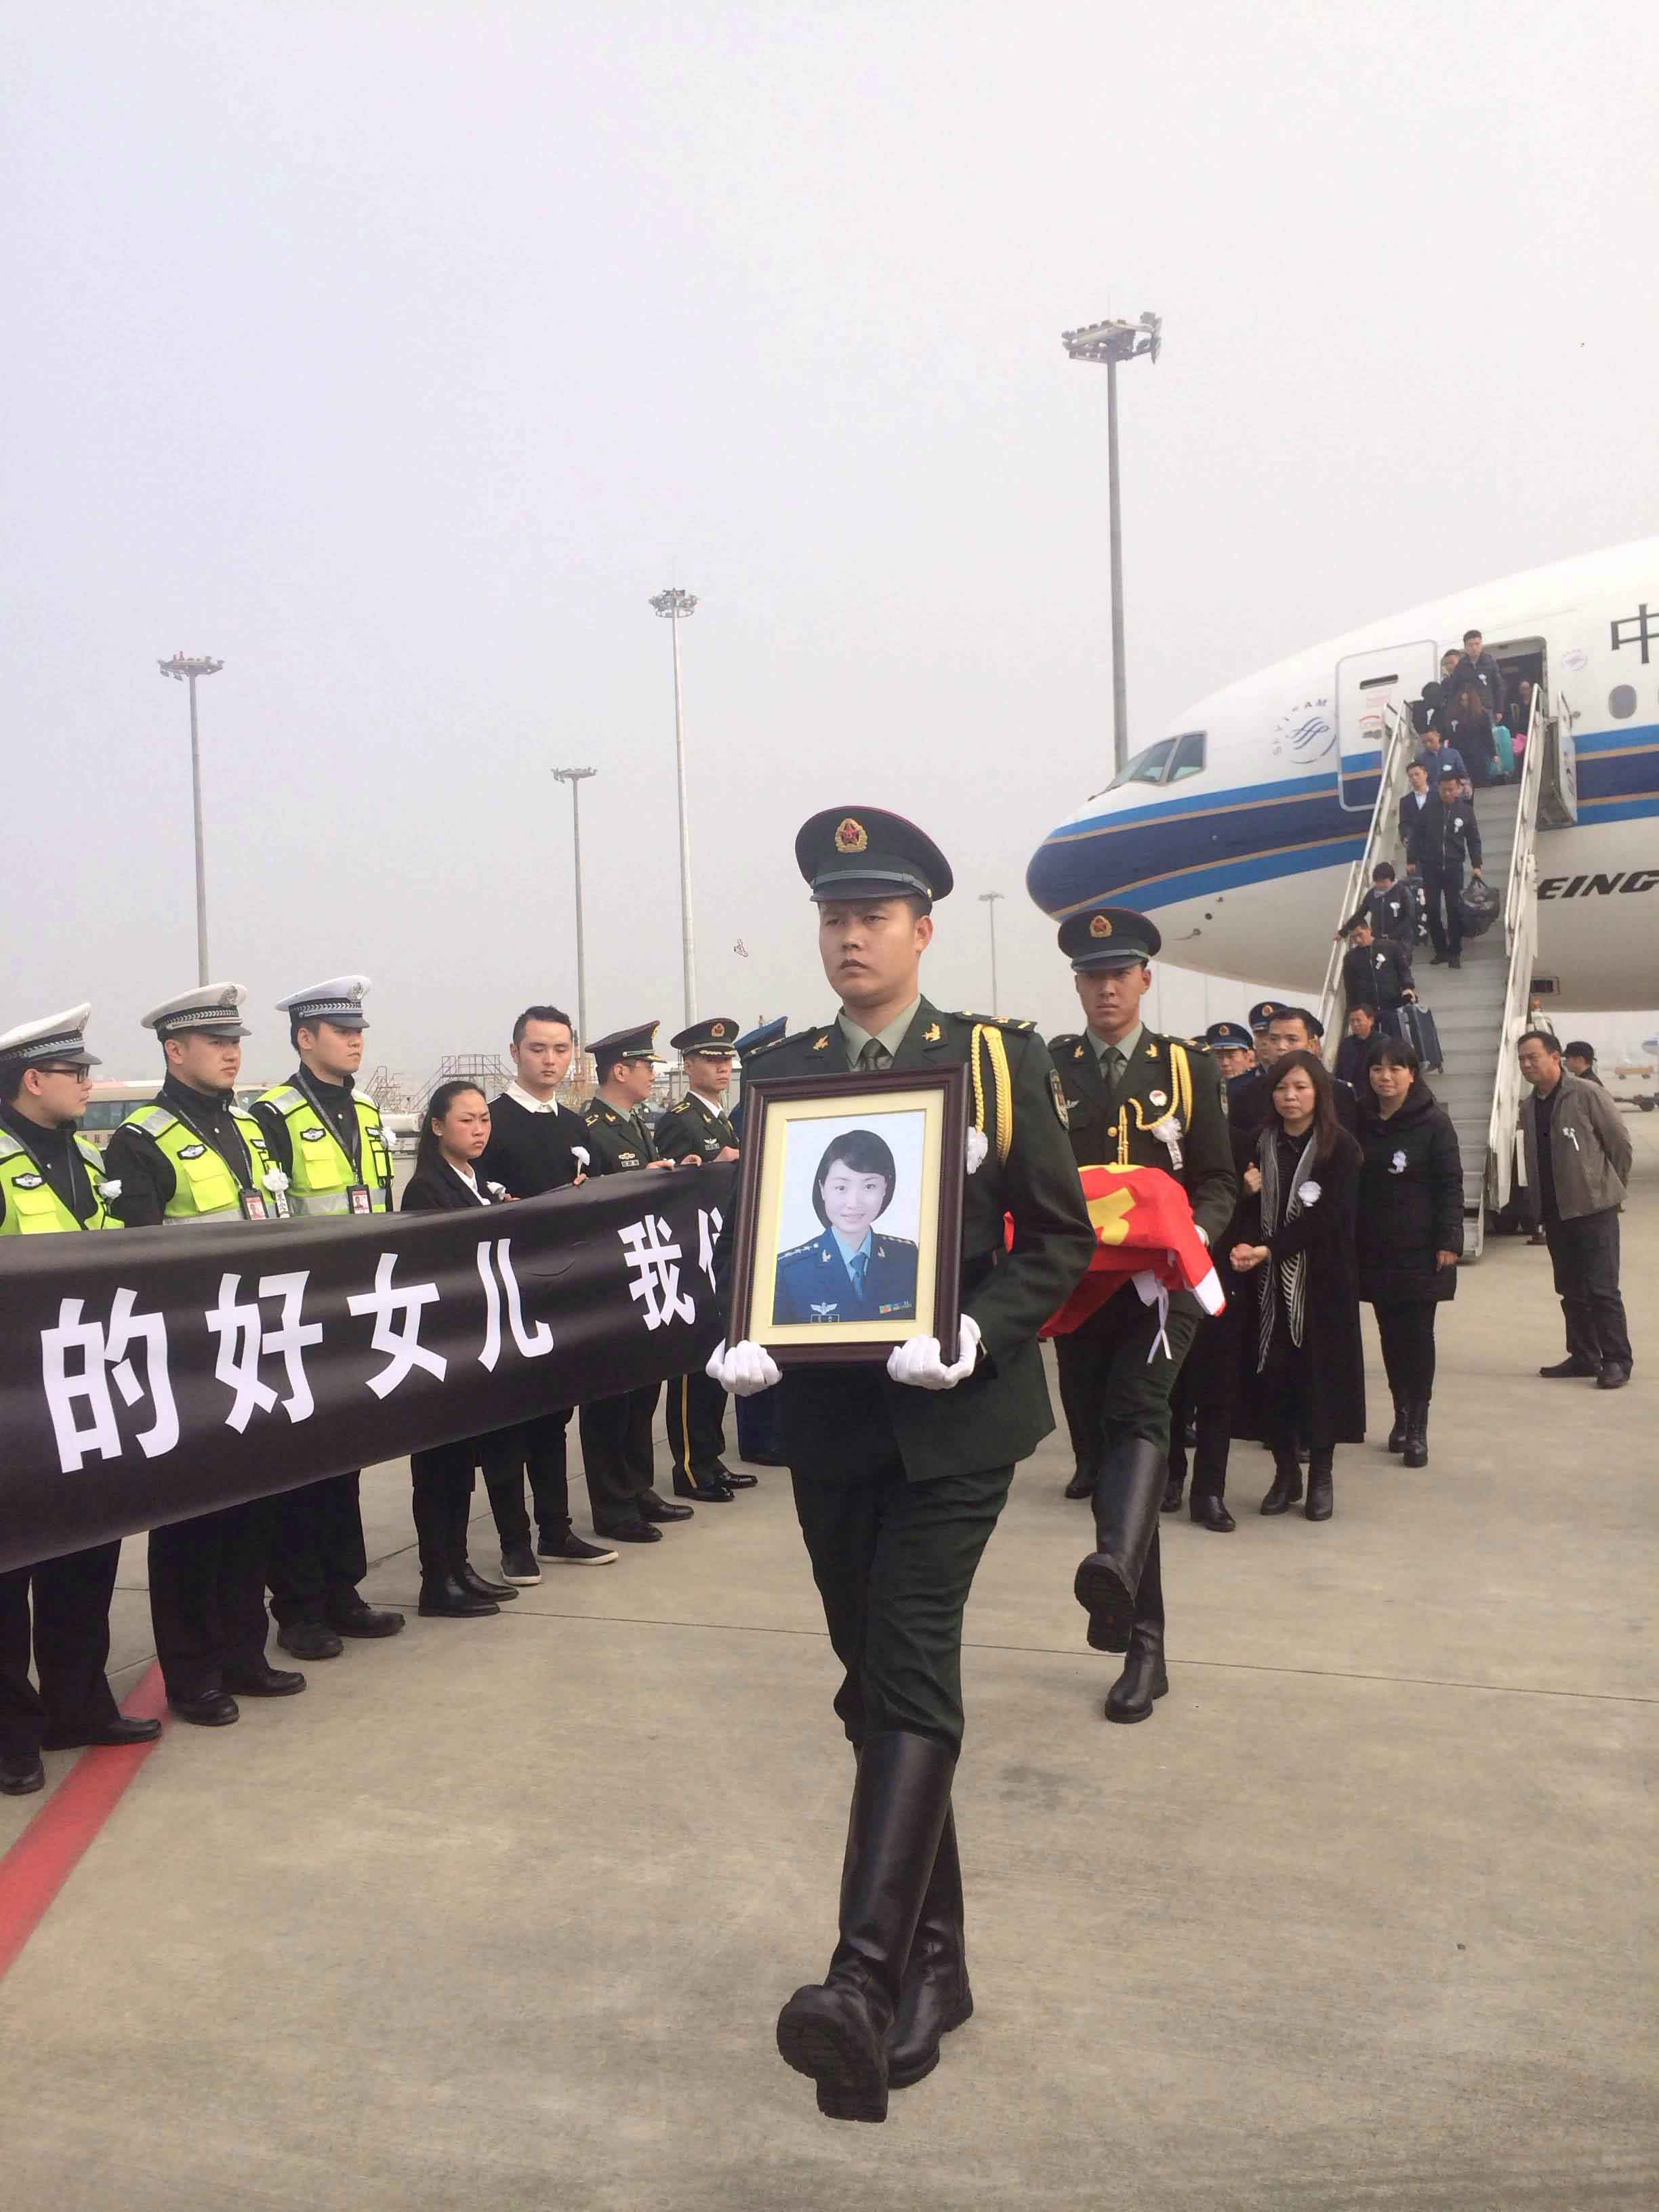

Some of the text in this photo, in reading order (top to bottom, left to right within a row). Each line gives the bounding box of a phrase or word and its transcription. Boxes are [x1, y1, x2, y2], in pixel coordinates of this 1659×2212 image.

[1611, 602, 1659, 665] 中
[41, 1238, 554, 1473] 的好女儿
